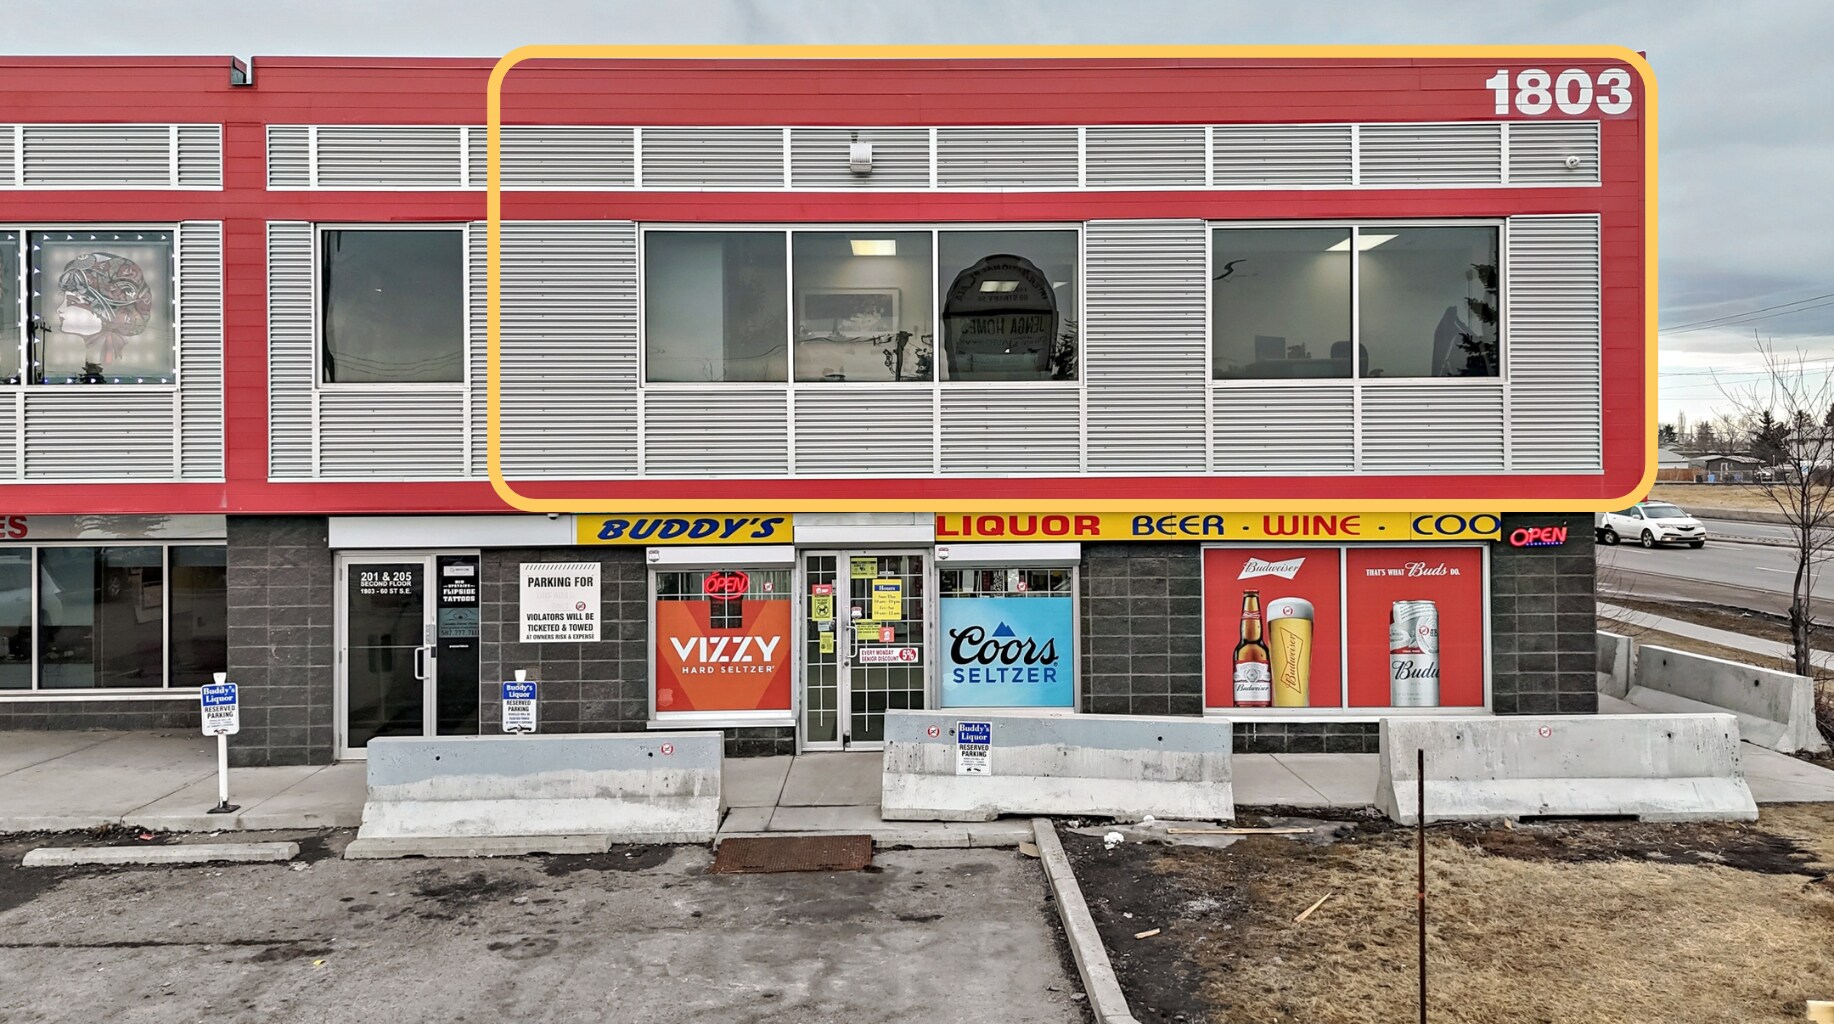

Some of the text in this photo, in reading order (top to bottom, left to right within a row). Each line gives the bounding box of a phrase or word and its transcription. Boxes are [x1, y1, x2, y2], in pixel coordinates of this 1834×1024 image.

[1485, 68, 1633, 115] 1803
[597, 518, 785, 540] BUDDY'S
[936, 514, 1501, 536] LIQUOR BEER WINE COO
[1510, 527, 1567, 546] OPEN
[1243, 561, 1298, 573] Budweiser
[1405, 562, 1448, 577] Buds
[1450, 568, 1460, 576] DO.
[361, 571, 412, 581] 201 & 205
[527, 577, 593, 587] PARKING FOR
[706, 577, 745, 592] OPEN
[526, 613, 564, 621] VIOLATORS
[669, 636, 781, 662] VIZZY
[949, 625, 1059, 666] Coors
[902, 649, 915, 660] 5%
[682, 665, 773, 674] HARD SELTZER
[953, 667, 1057, 683] SELTZER
[203, 685, 235, 695] Buddy's
[506, 684, 533, 692] Buddy's
[205, 695, 234, 704] Liquor
[959, 724, 989, 734] Buddy's
[961, 732, 988, 742] Liquor
